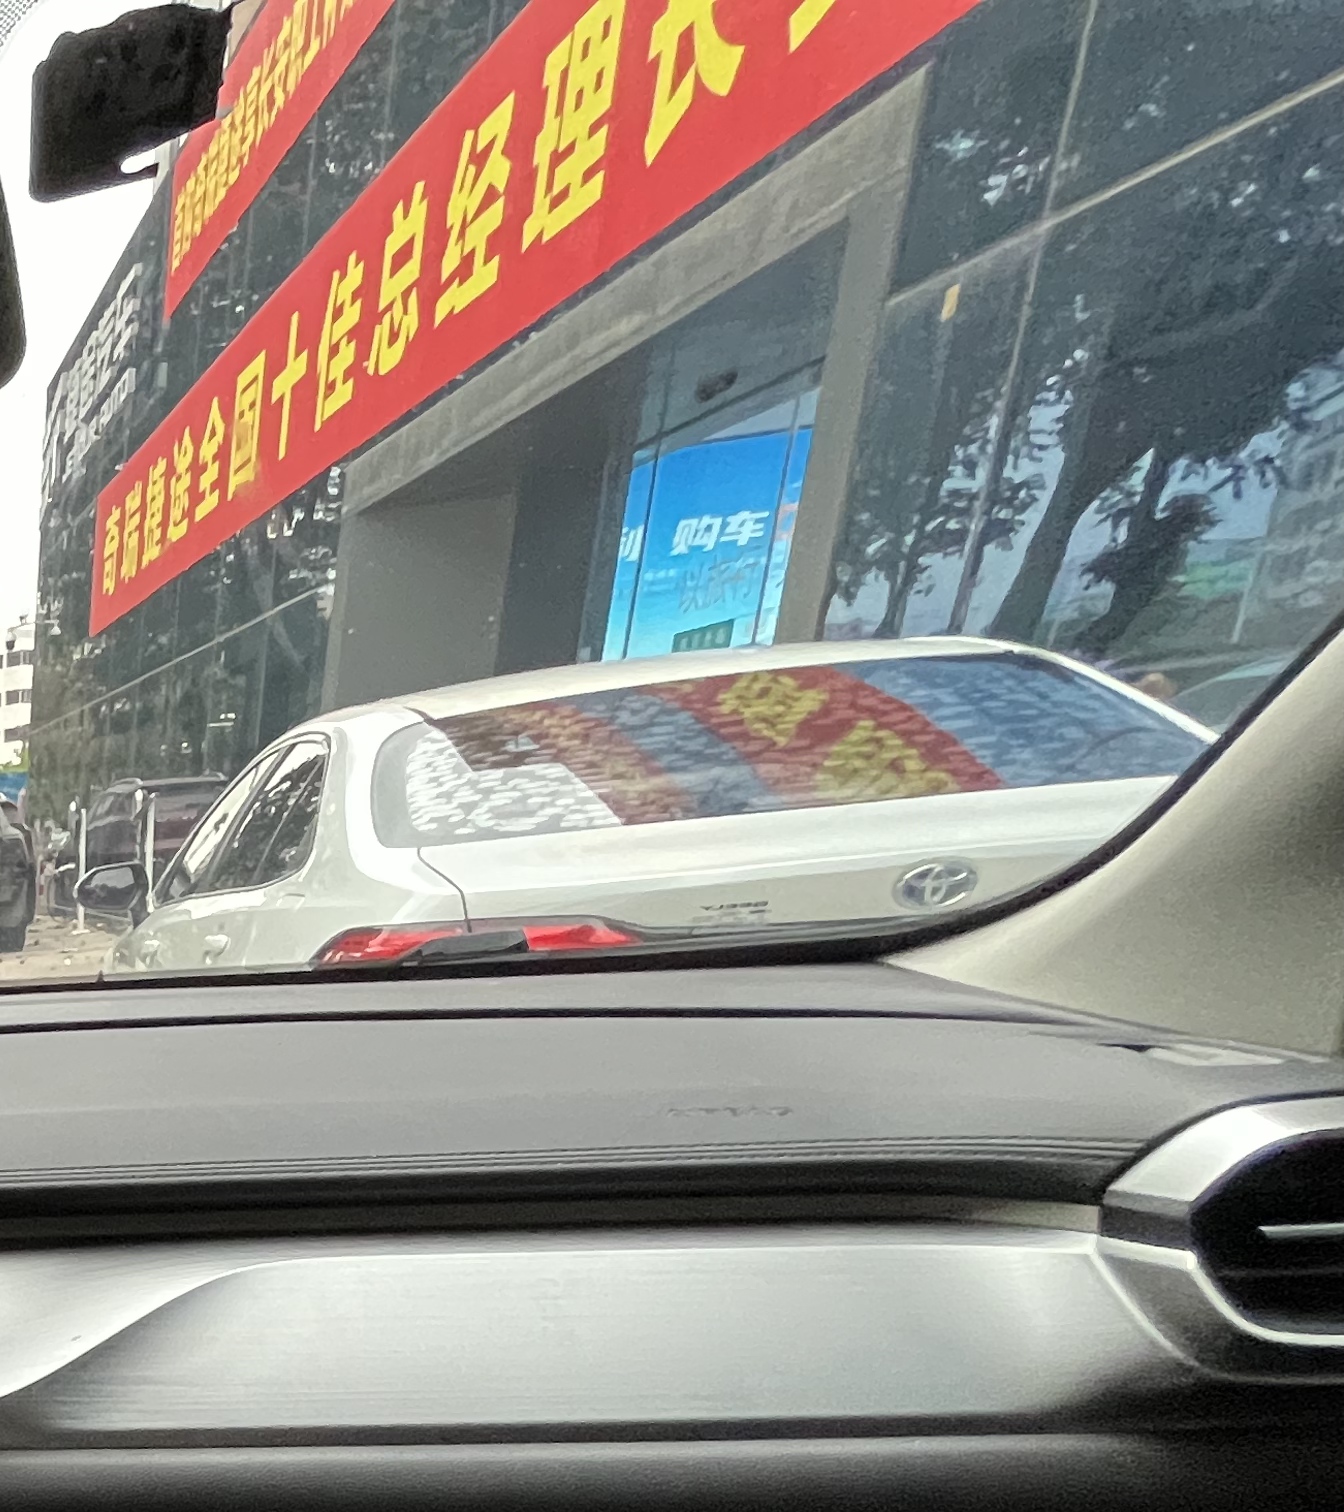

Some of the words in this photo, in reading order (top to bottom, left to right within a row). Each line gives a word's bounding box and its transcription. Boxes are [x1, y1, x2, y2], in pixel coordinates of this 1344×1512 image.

[102, 0, 837, 597] 奇瑞捷途全国十佳总经理长
[669, 509, 770, 557] 购车
